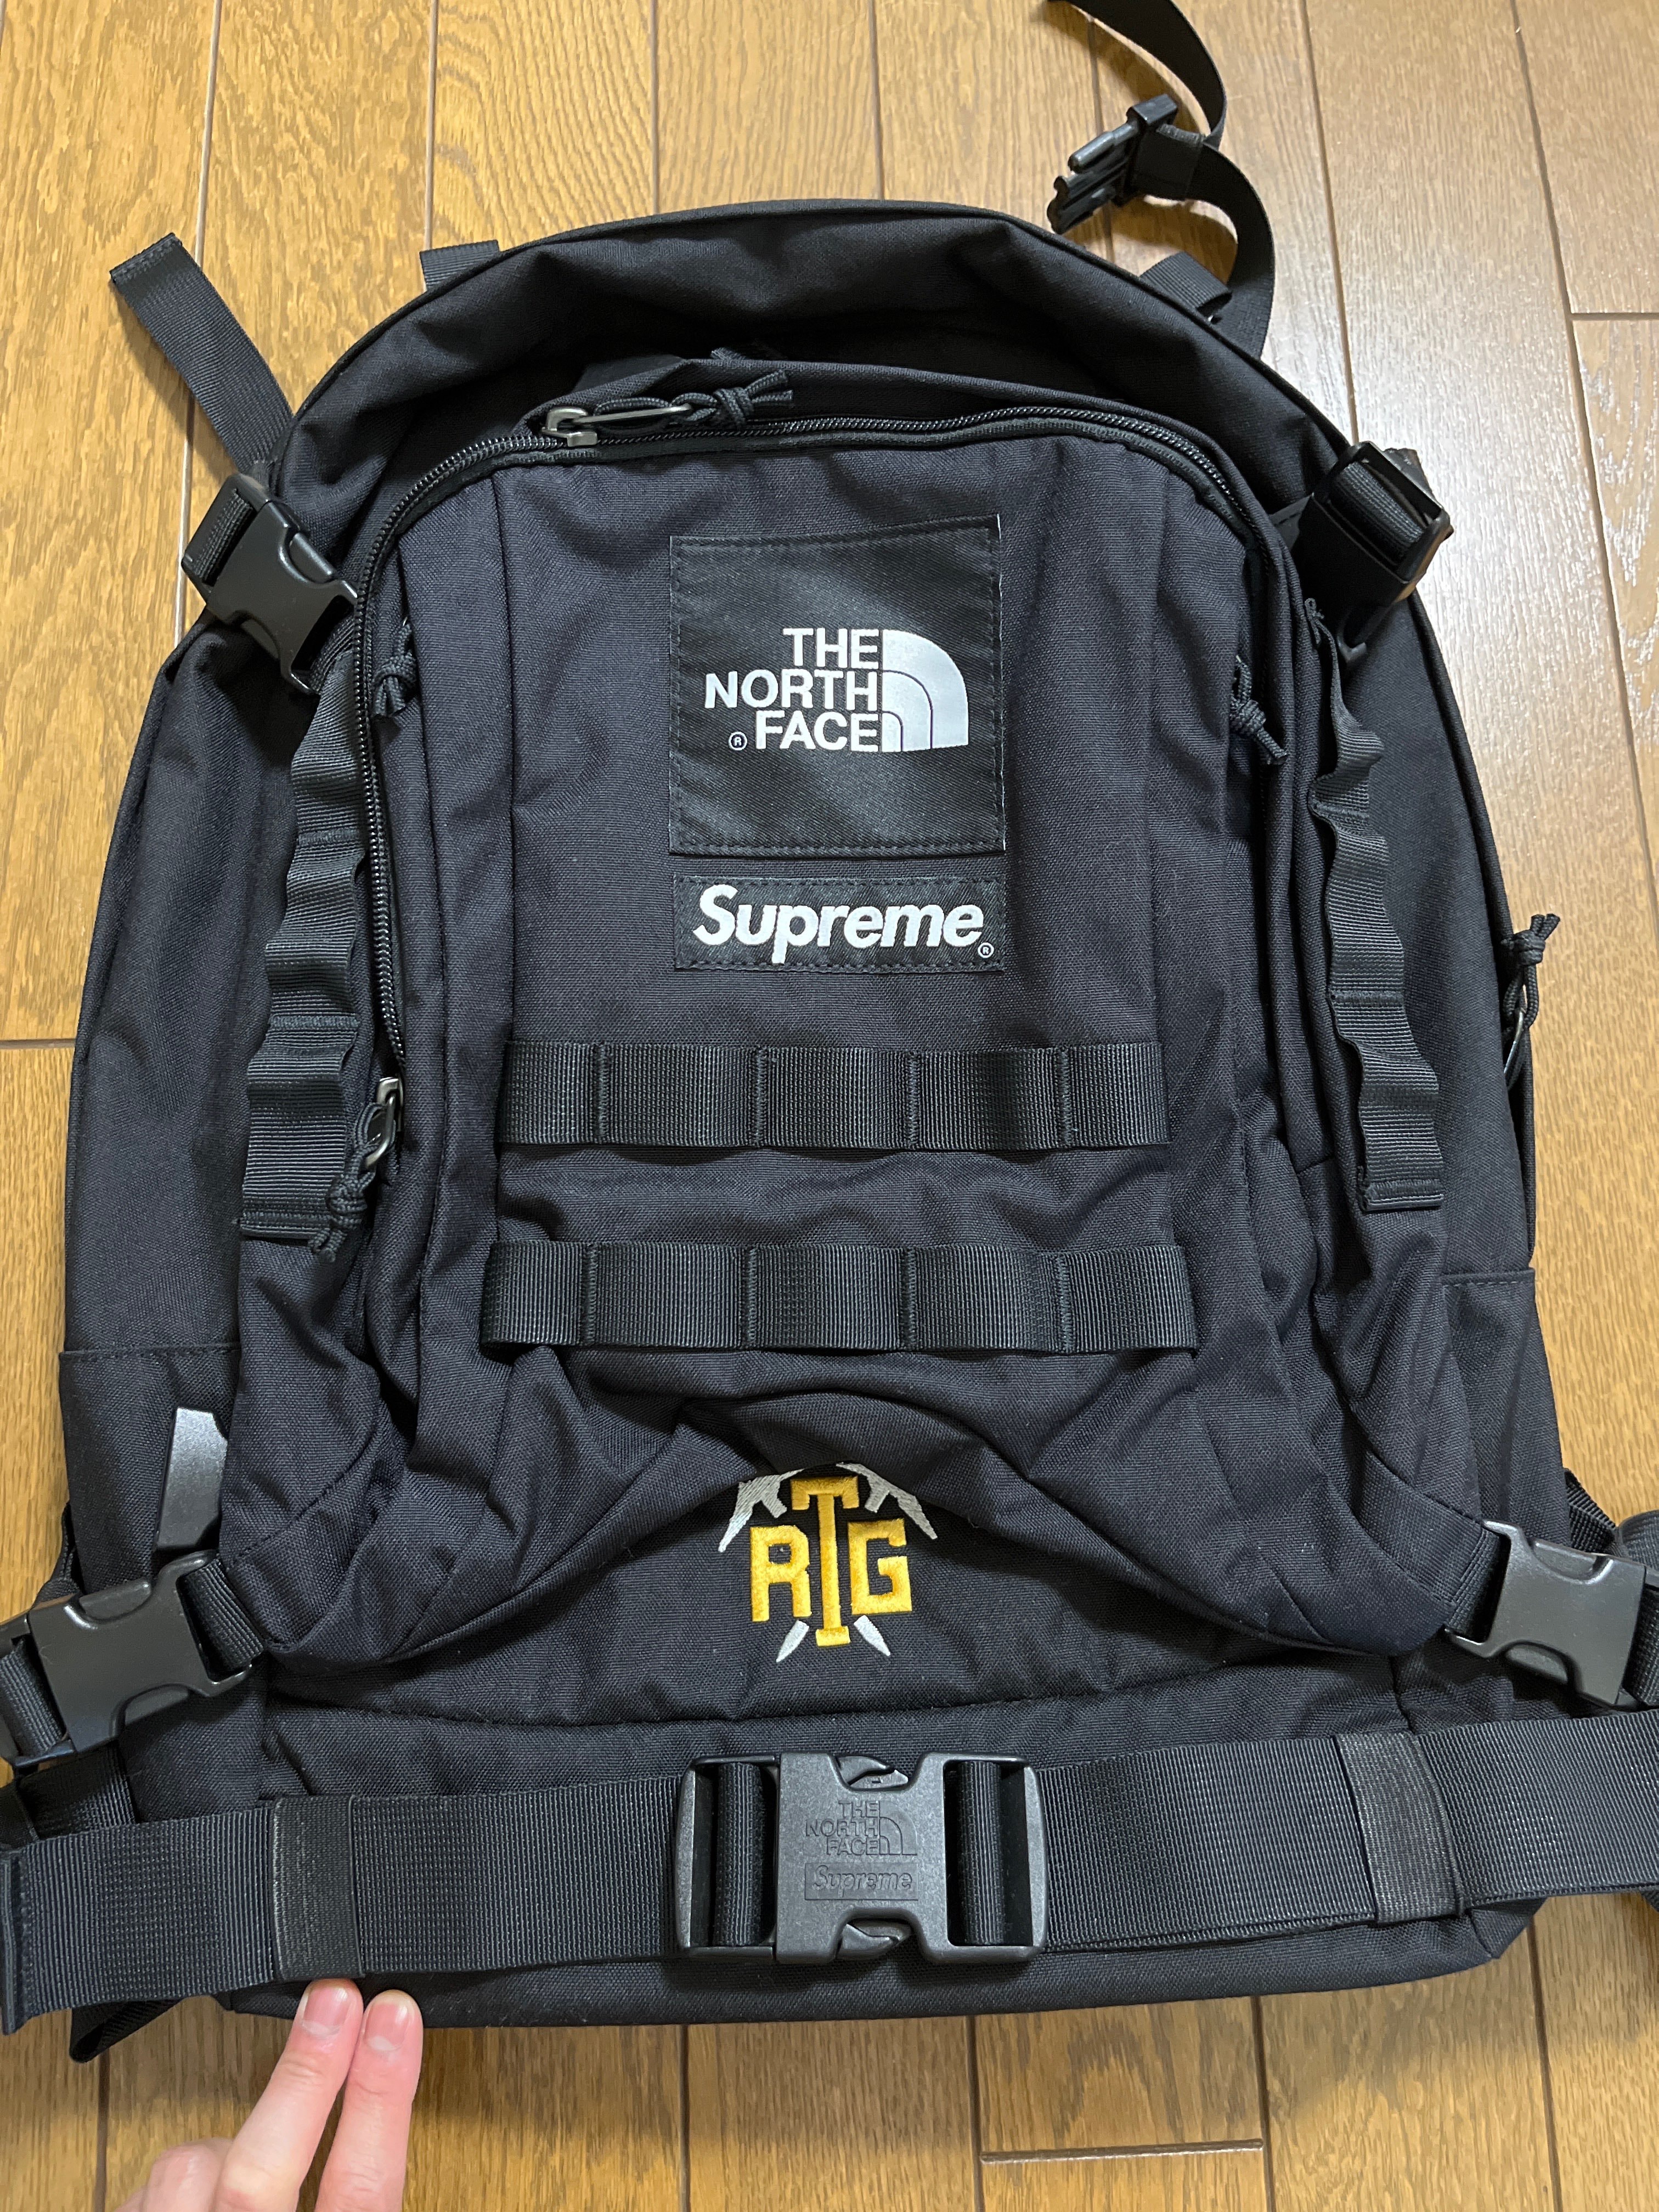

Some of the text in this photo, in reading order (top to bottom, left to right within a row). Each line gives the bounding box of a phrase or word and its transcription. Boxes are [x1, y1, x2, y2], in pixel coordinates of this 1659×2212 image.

[783, 628, 879, 669] THE
[704, 669, 878, 712] NORTH
[755, 710, 879, 752] FACE
[693, 884, 985, 964] Supreme
[838, 1800, 880, 1818] THE
[805, 1819, 878, 1837] NORTH
[826, 1837, 880, 1856] FACE
[812, 1865, 913, 1898] Supreme
